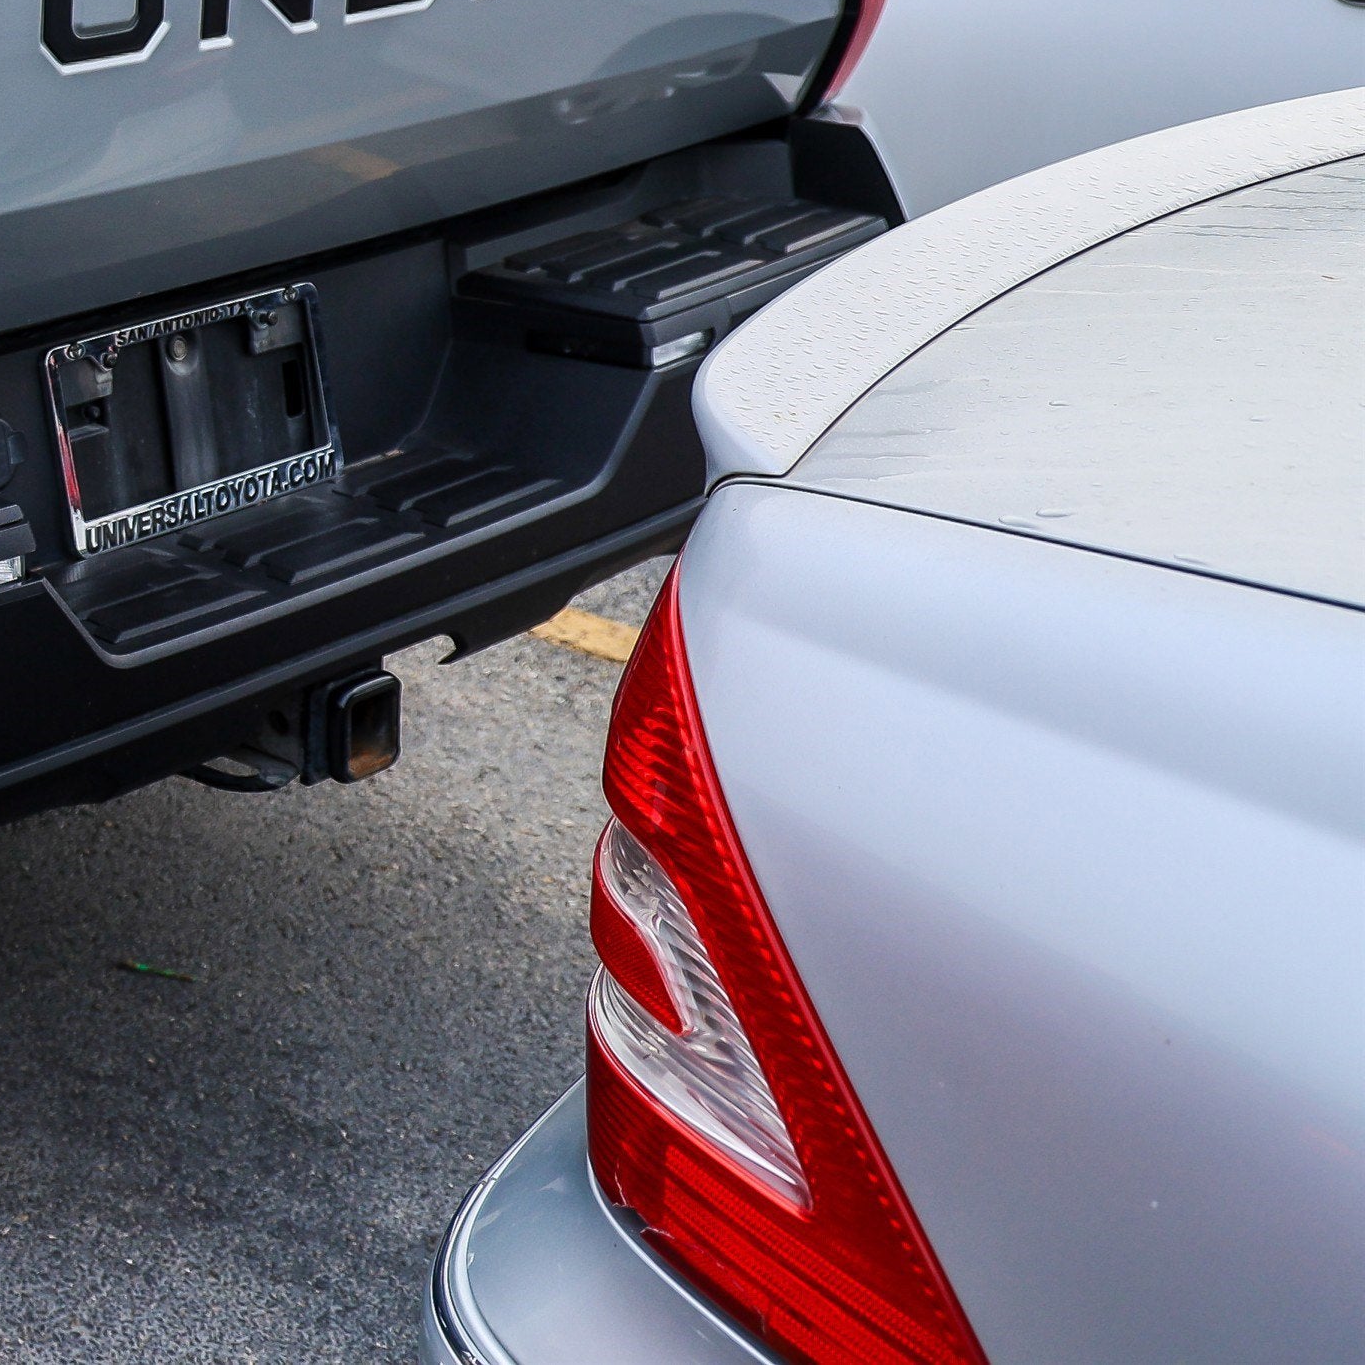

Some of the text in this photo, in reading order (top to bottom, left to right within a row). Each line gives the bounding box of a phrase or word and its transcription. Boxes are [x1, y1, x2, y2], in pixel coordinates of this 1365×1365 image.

[115, 323, 152, 347] SAN
[226, 299, 249, 319] TX
[85, 449, 337, 554] UNIVERSALTOYOTA.COM
